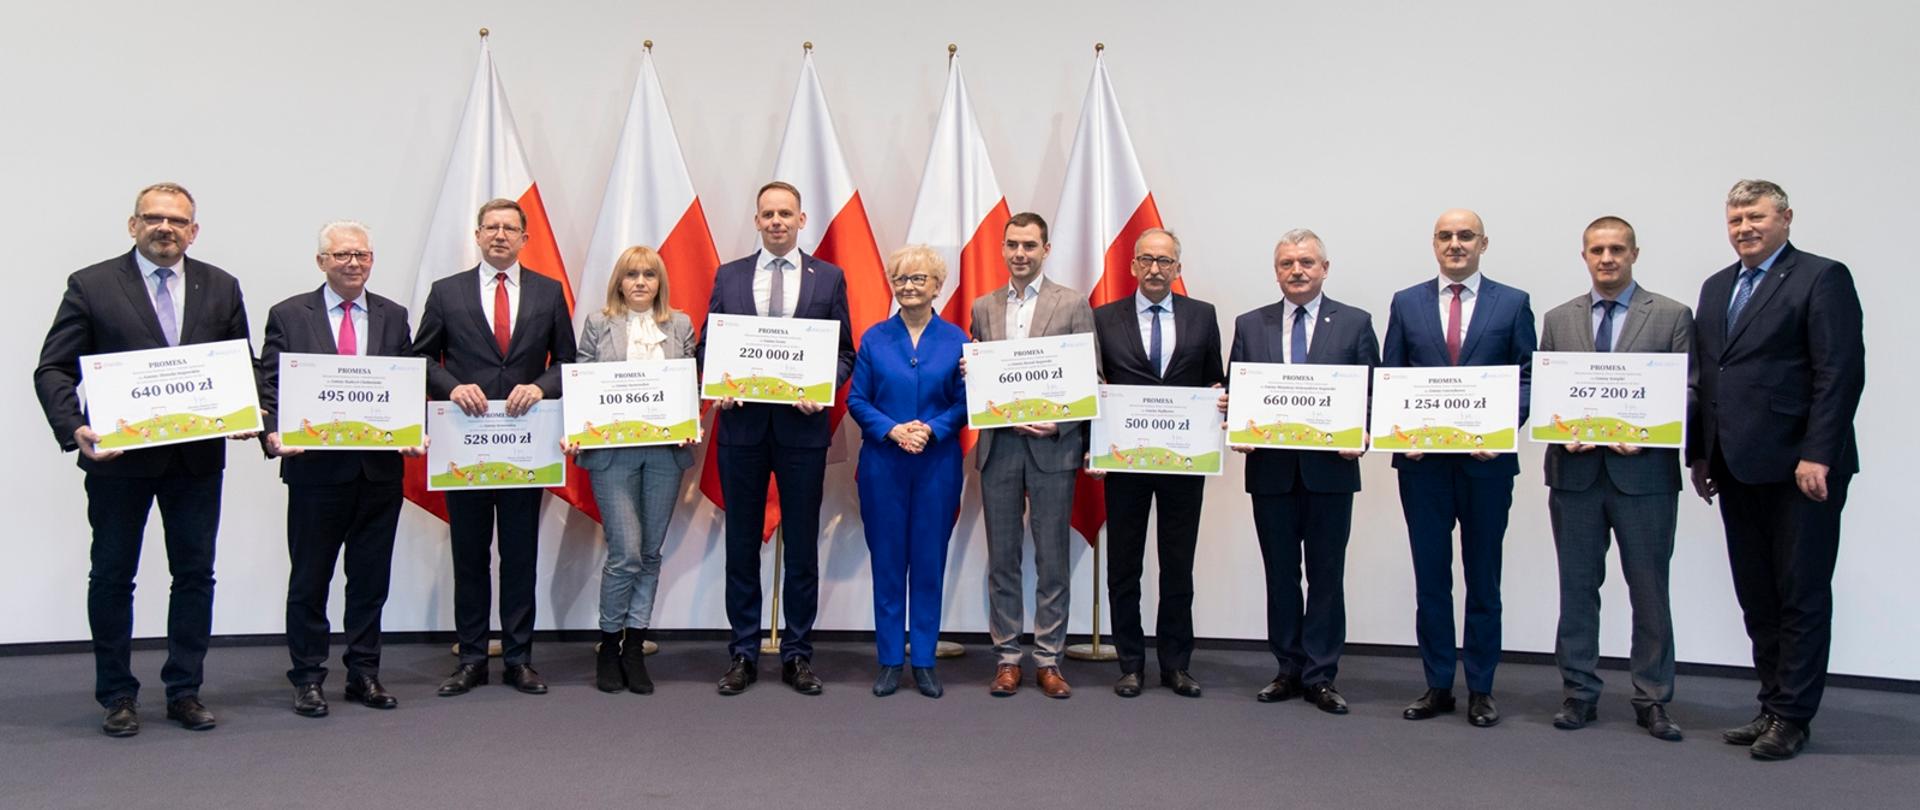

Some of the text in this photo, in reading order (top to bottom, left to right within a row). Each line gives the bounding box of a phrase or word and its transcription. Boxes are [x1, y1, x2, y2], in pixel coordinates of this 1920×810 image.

[758, 327, 788, 335] PROMESA
[739, 347, 804, 361] 220 000 zł
[149, 359, 187, 368] PROMESA
[999, 367, 1063, 384] 660 000 zł
[131, 384, 161, 399] 640
[165, 380, 195, 395] 000
[198, 377, 213, 391] zł
[1569, 386, 1645, 399] 267 200 zł
[318, 390, 389, 402] 495 000 zł
[600, 390, 664, 405] 100 866 zł
[1263, 395, 1331, 407] 660 000 zł
[1403, 397, 1486, 409] 1 254 000 zł
[1124, 418, 1190, 430] 500 000 zł
[464, 432, 531, 445] 528 000 zł
